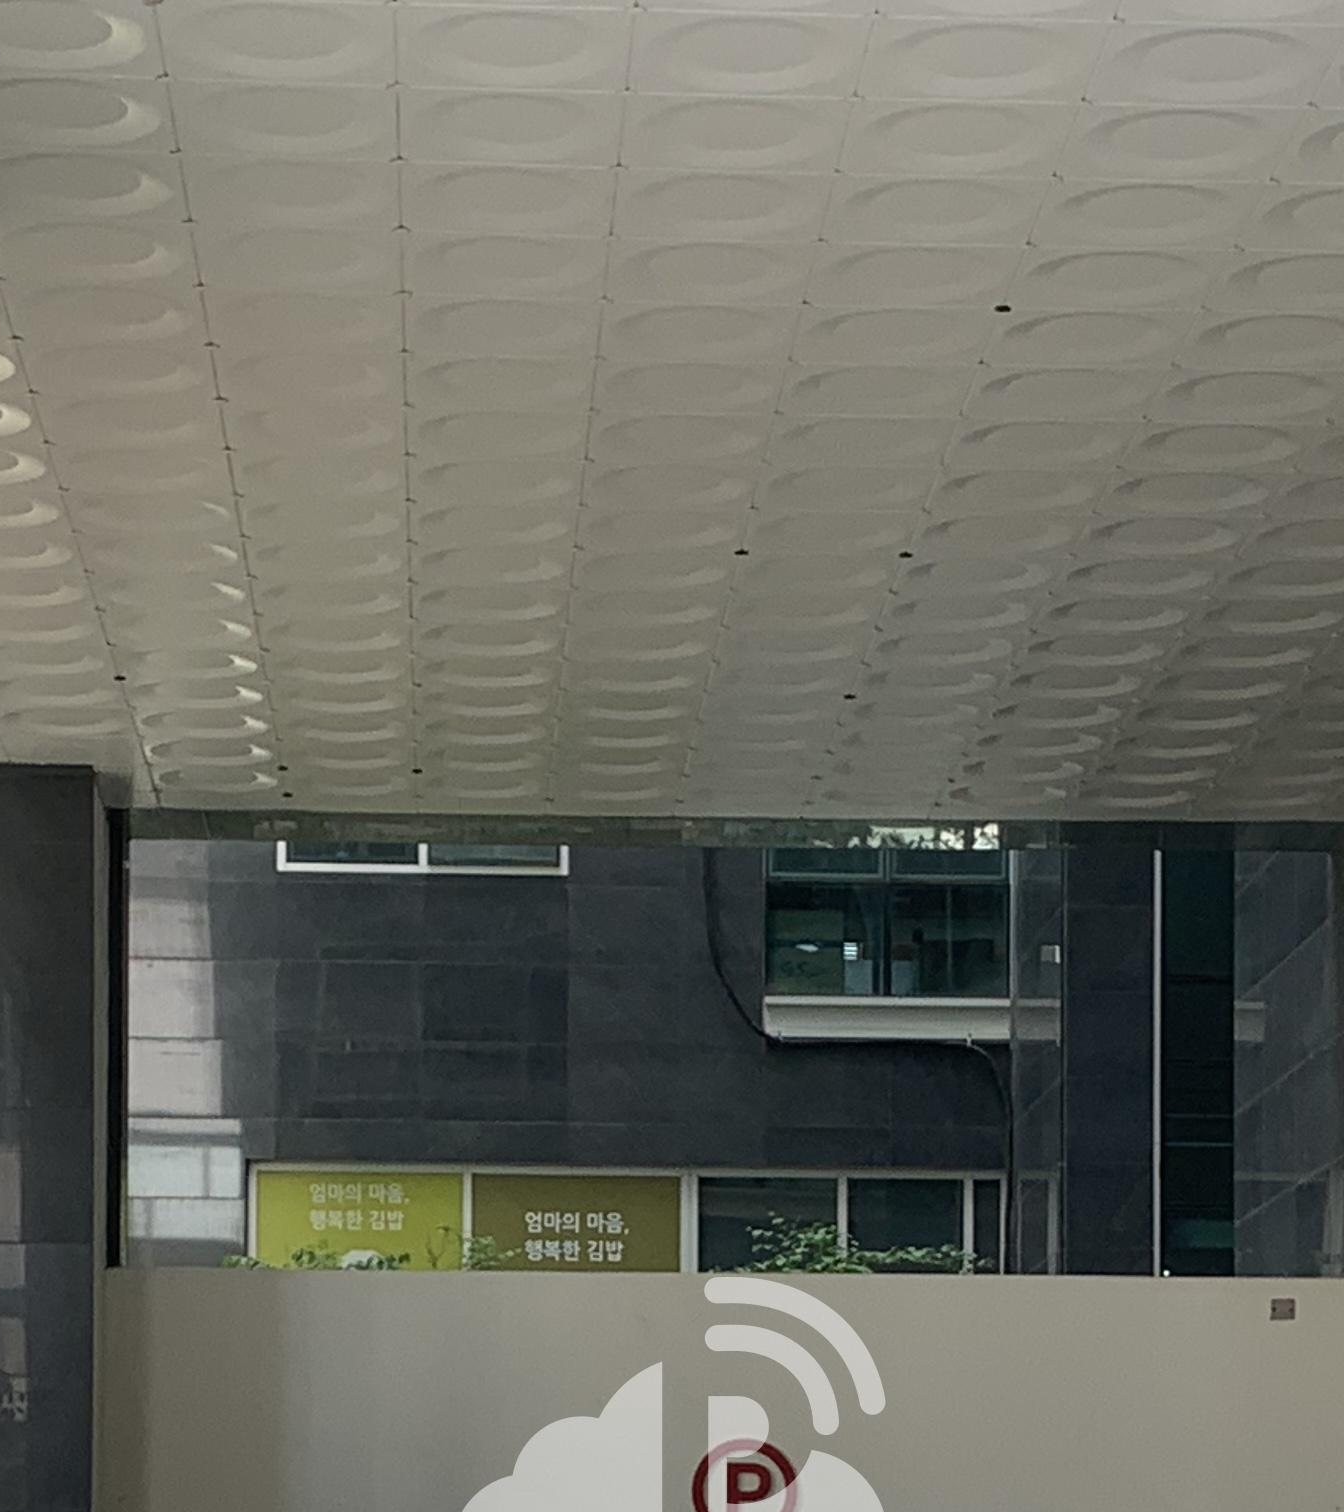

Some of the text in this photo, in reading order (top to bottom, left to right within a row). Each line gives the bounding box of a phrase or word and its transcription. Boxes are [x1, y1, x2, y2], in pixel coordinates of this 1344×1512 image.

[309, 1182, 410, 1204] 엄마의 마음,
[309, 1210, 404, 1231] 행복한 김밥
[524, 1211, 629, 1235] 엄마의 마음,
[524, 1239, 623, 1262] 행복한 김밥
